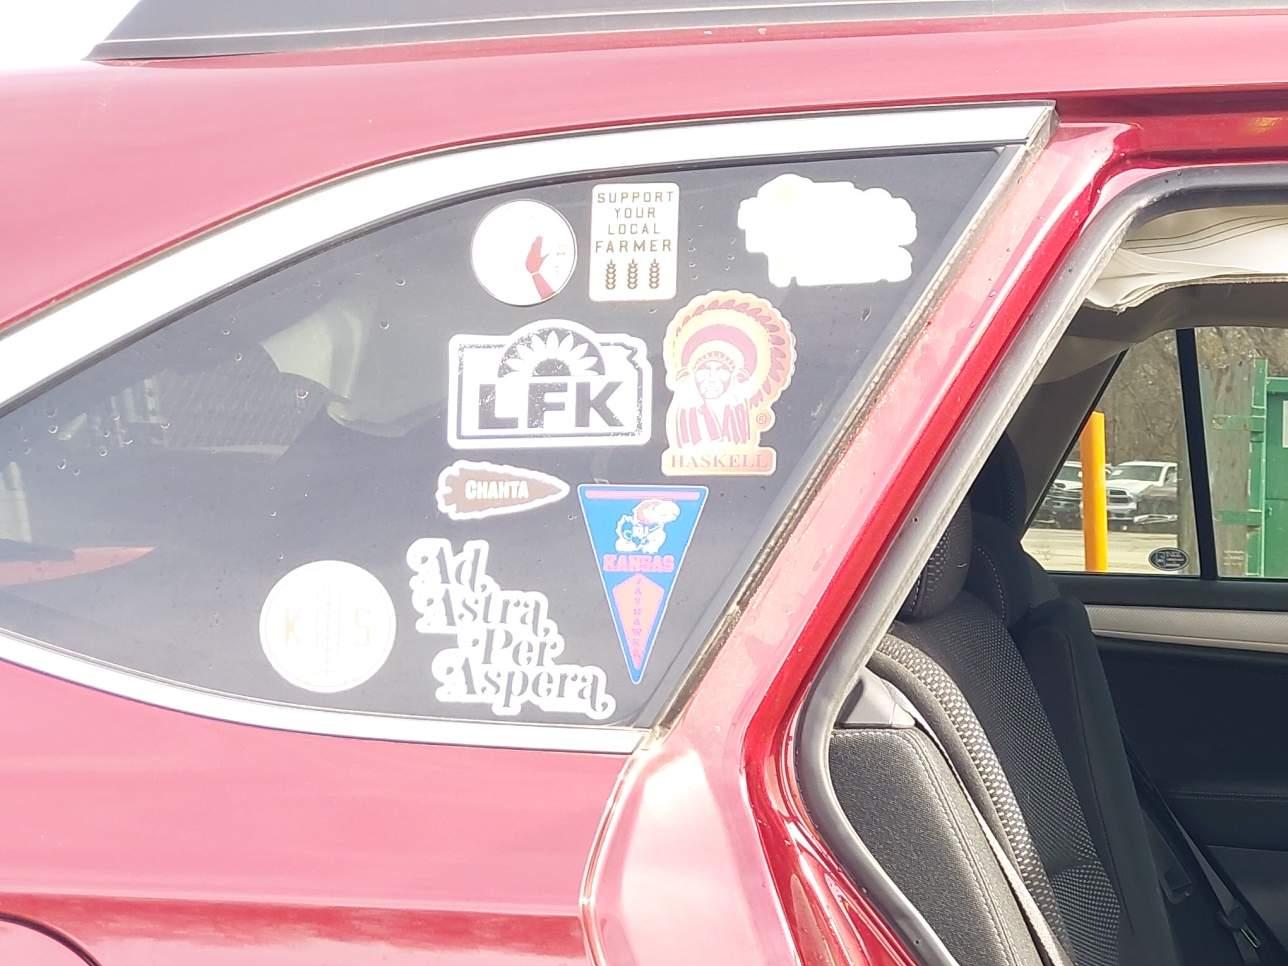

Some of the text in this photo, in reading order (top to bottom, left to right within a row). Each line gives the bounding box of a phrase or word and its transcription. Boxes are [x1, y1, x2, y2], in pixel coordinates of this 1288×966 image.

[597, 191, 674, 204] SUPPORT
[614, 207, 656, 219] YOUR
[607, 223, 661, 235] LOCAL
[595, 239, 672, 253] FARMER
[478, 380, 624, 430] LFK
[671, 454, 769, 469] HASKELL
[603, 554, 674, 573] KANSAS
